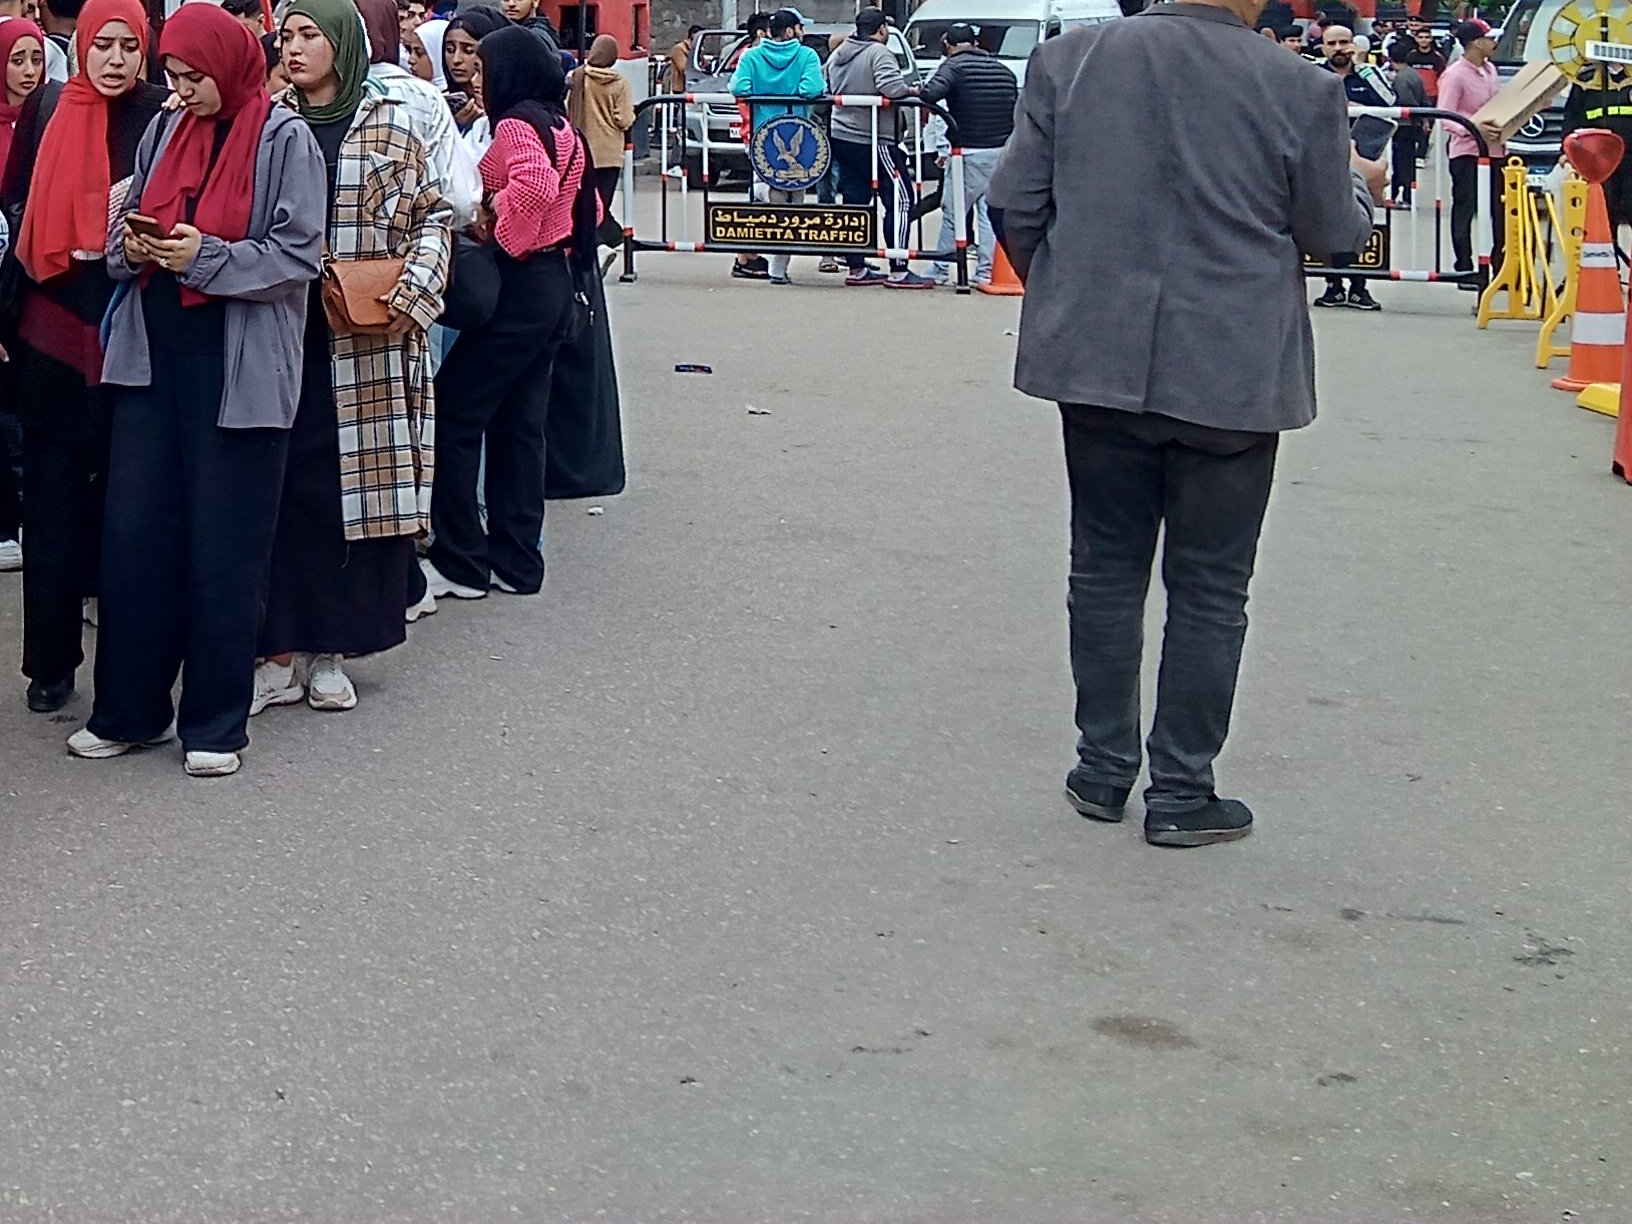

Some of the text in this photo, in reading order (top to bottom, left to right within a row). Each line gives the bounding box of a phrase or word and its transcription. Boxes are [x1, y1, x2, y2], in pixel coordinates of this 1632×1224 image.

[715, 210, 866, 230] إدارة مرور دمياط
[716, 227, 865, 242] DAMIETTA TRAFFIC
